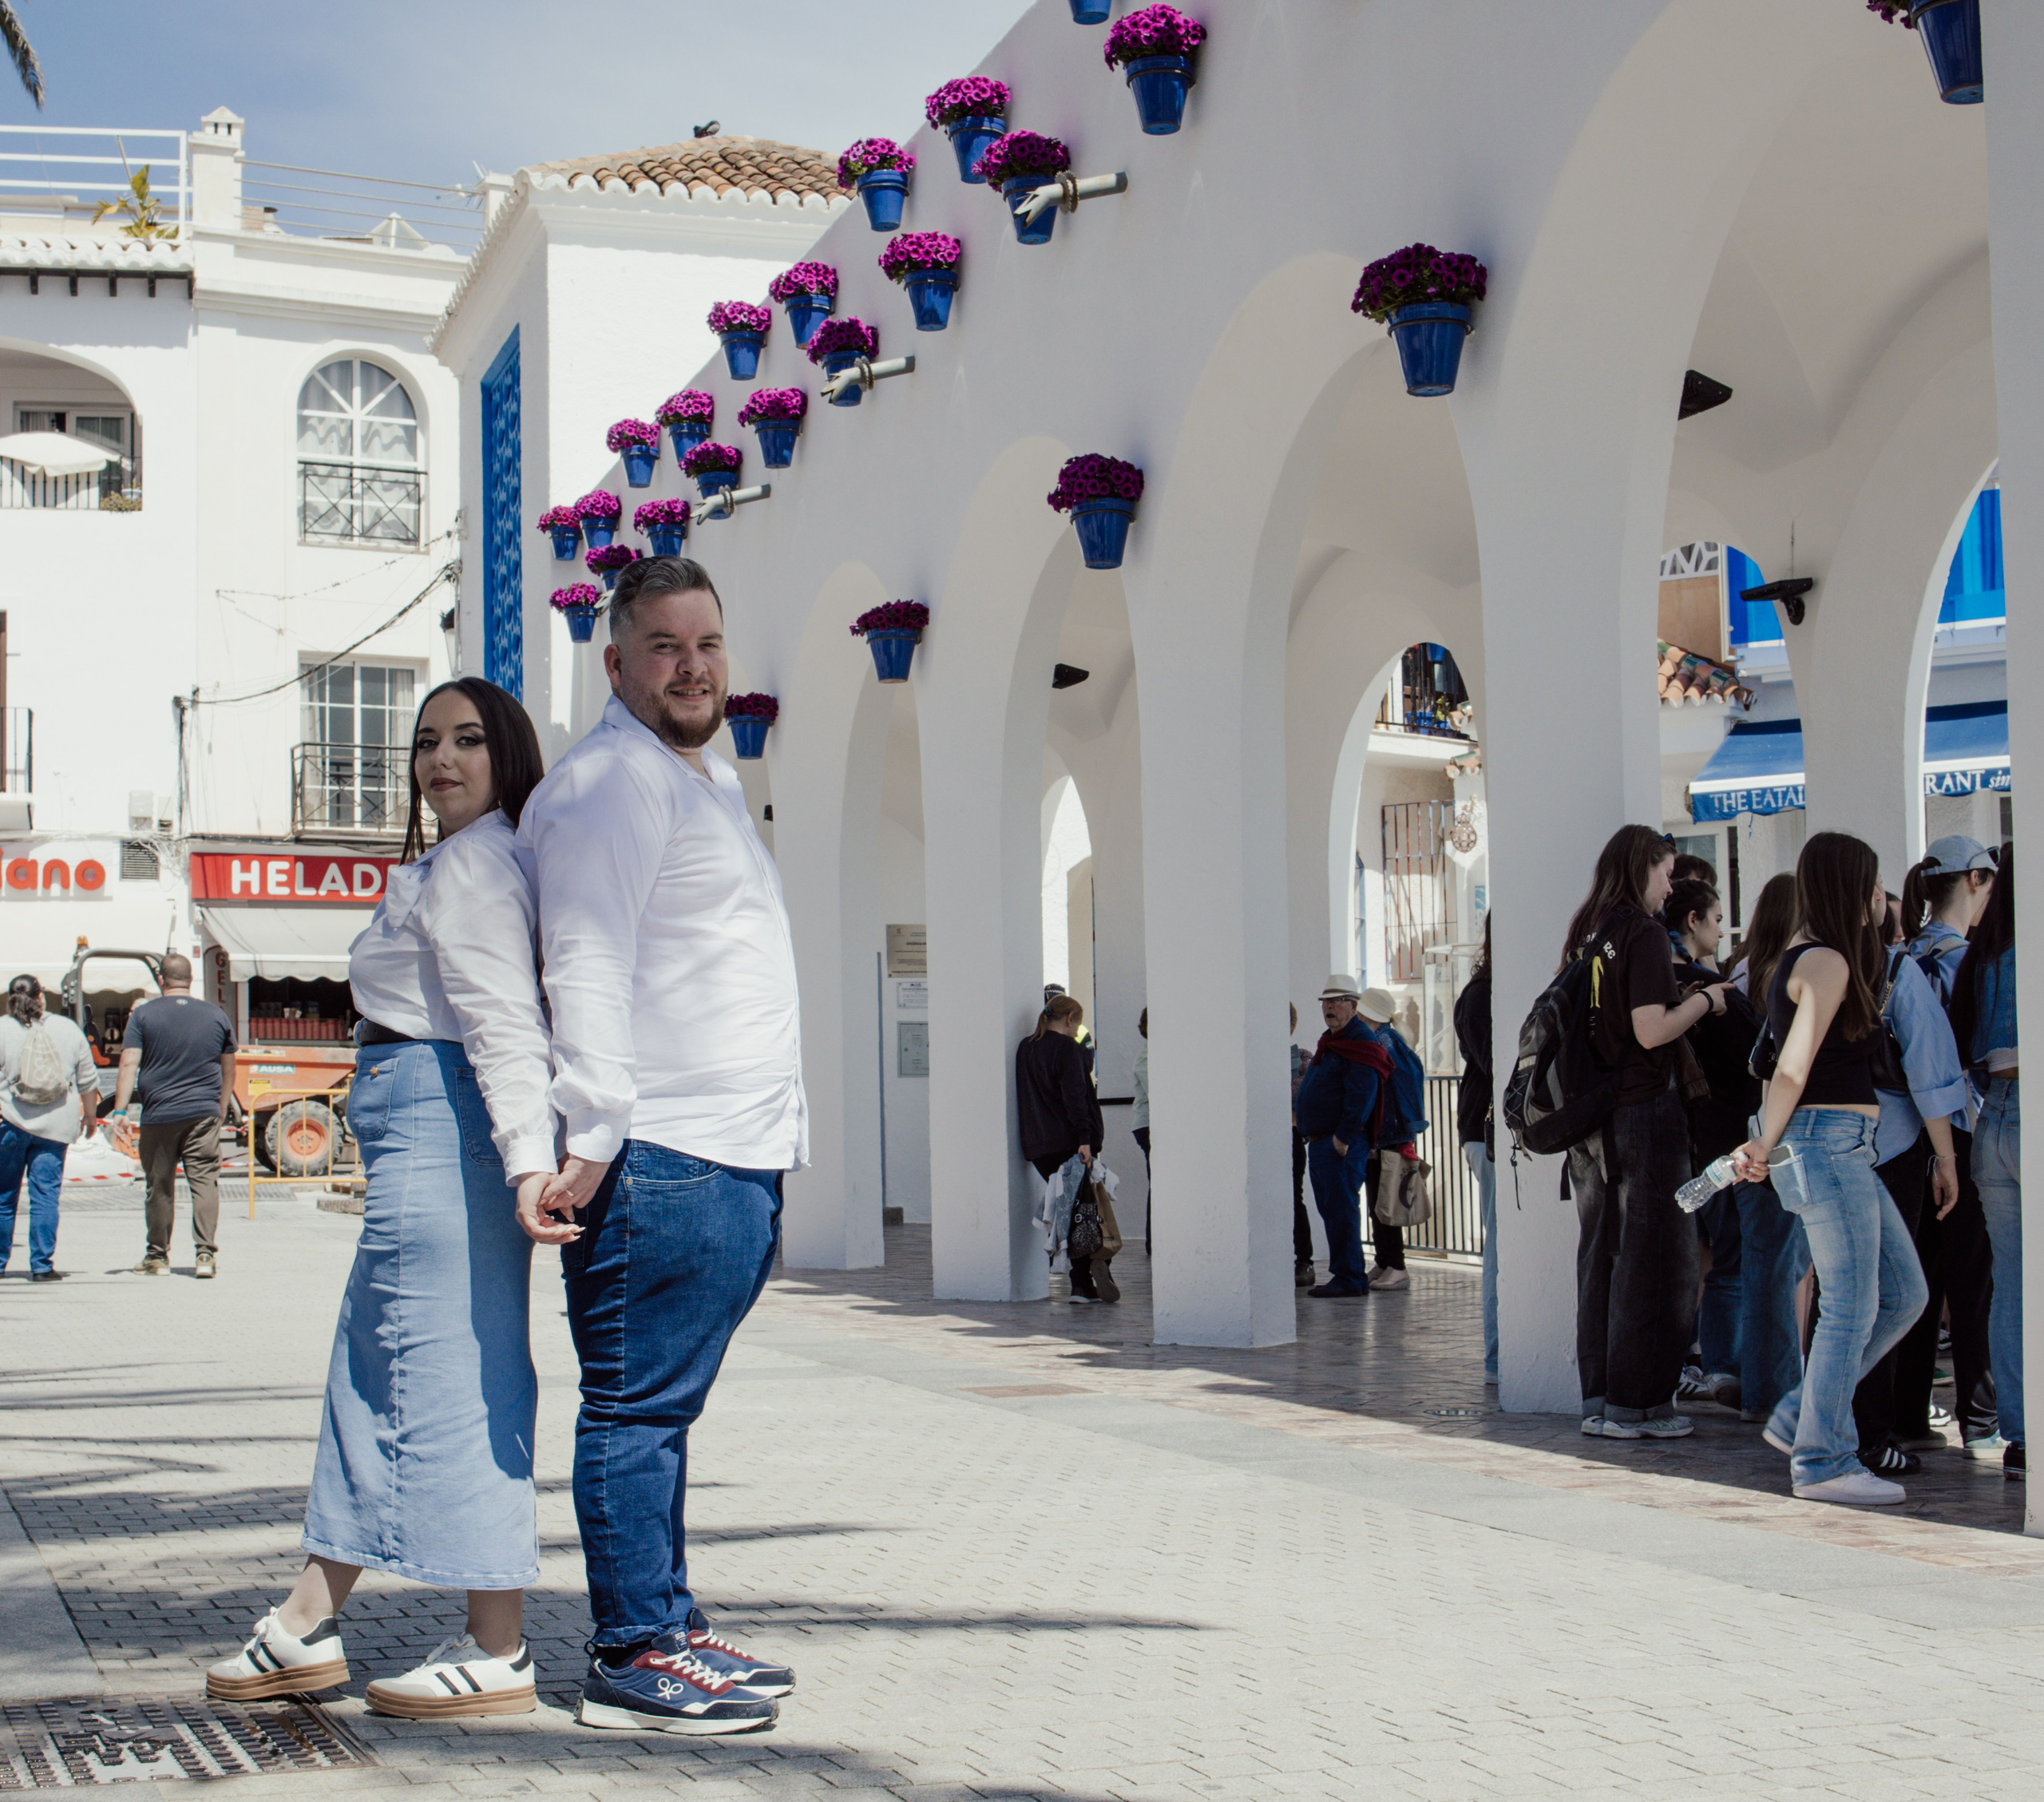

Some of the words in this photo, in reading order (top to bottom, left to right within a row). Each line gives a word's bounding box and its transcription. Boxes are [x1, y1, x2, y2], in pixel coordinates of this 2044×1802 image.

[1710, 791, 1749, 813] THE
[1751, 786, 1805, 810] EATAL
[0, 847, 105, 890] ano
[232, 860, 398, 897] HELAD
